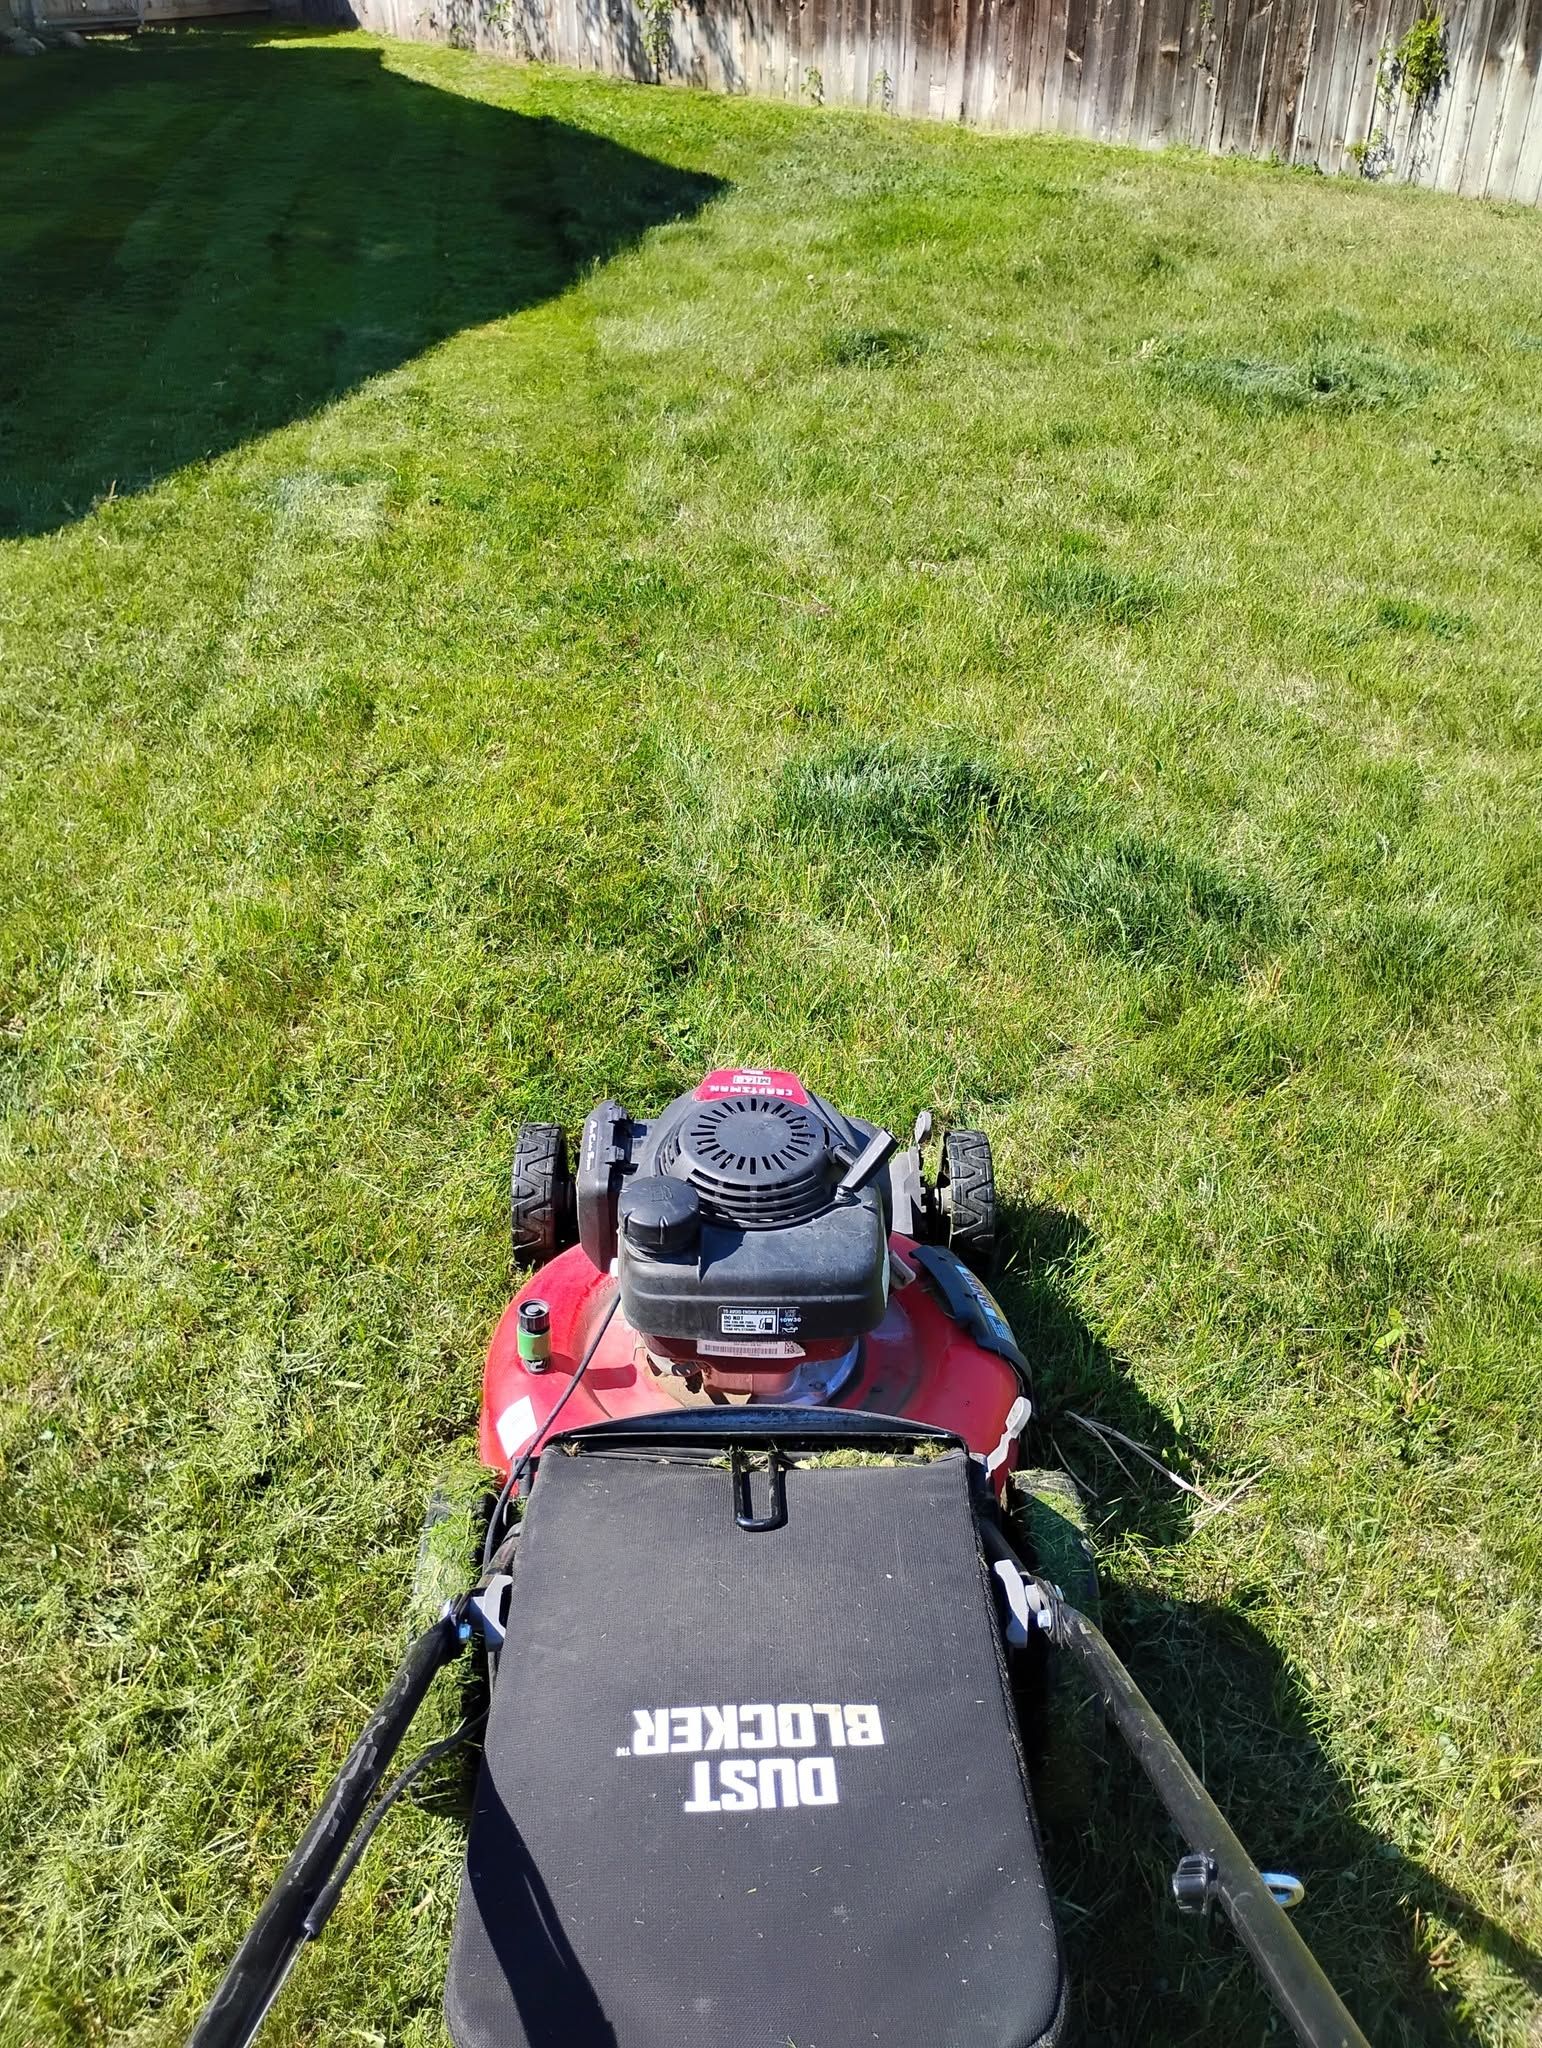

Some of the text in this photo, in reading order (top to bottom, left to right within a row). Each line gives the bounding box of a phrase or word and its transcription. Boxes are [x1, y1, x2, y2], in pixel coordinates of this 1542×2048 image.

[710, 1085, 793, 1096] CRAFTSMAN
[632, 1703, 885, 1756] BLOCKER
[684, 1757, 839, 1812] DUST
